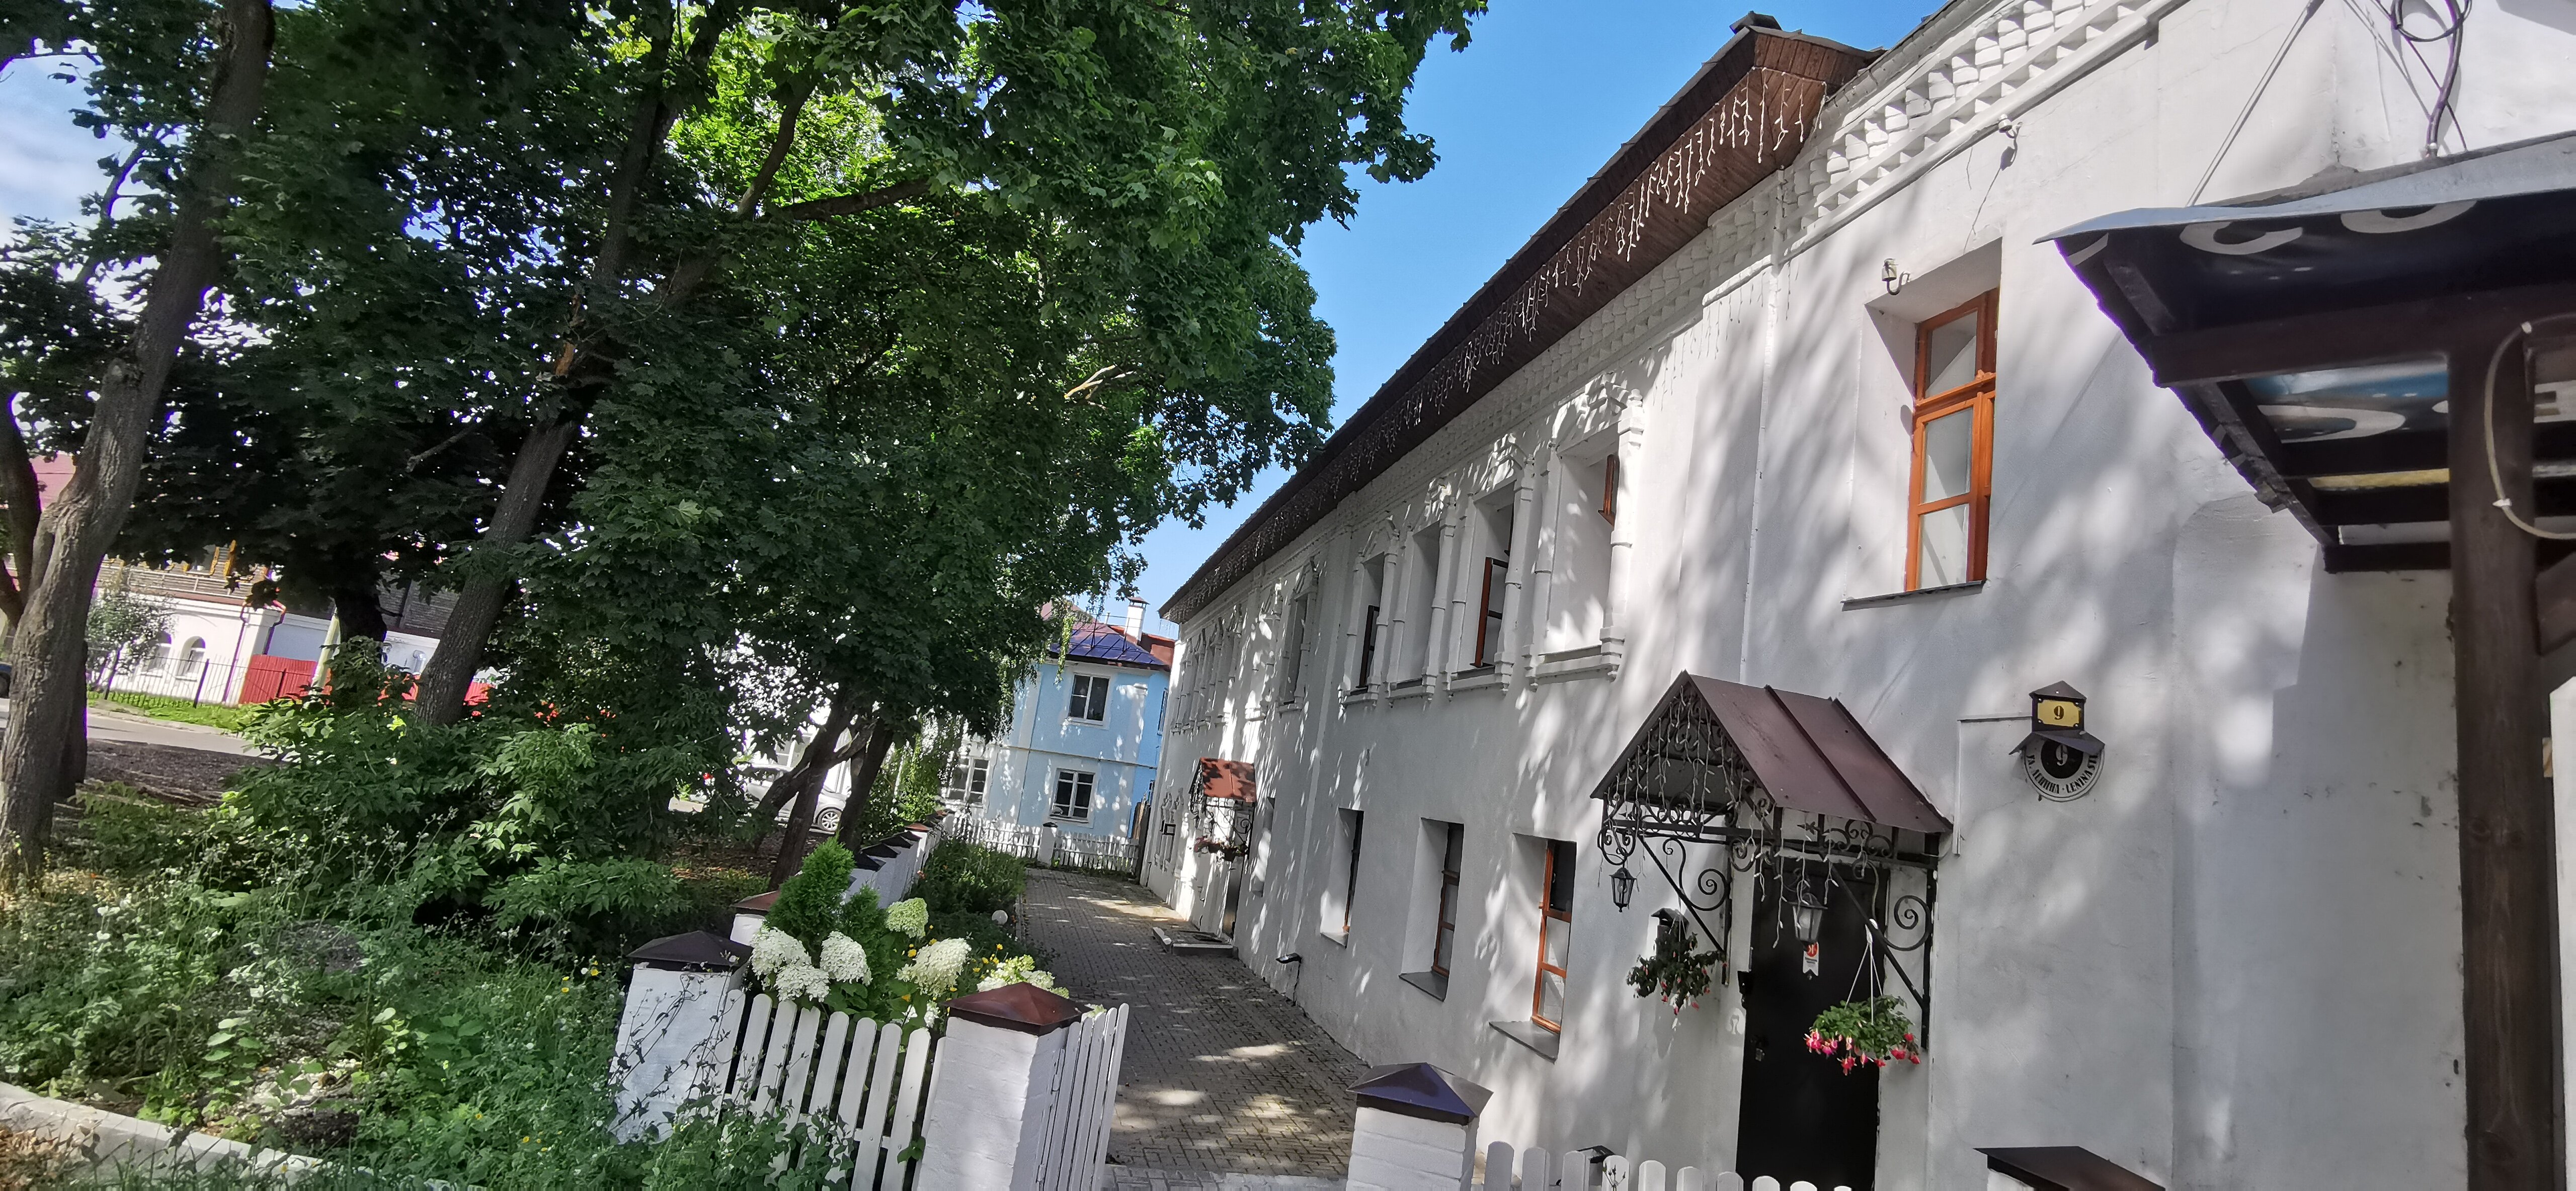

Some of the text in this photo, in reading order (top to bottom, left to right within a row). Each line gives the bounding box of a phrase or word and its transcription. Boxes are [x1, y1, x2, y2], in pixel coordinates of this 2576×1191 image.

[2053, 705, 2064, 720] 9
[2056, 744, 2068, 766] 9
[2065, 770, 2093, 794] LENINA
